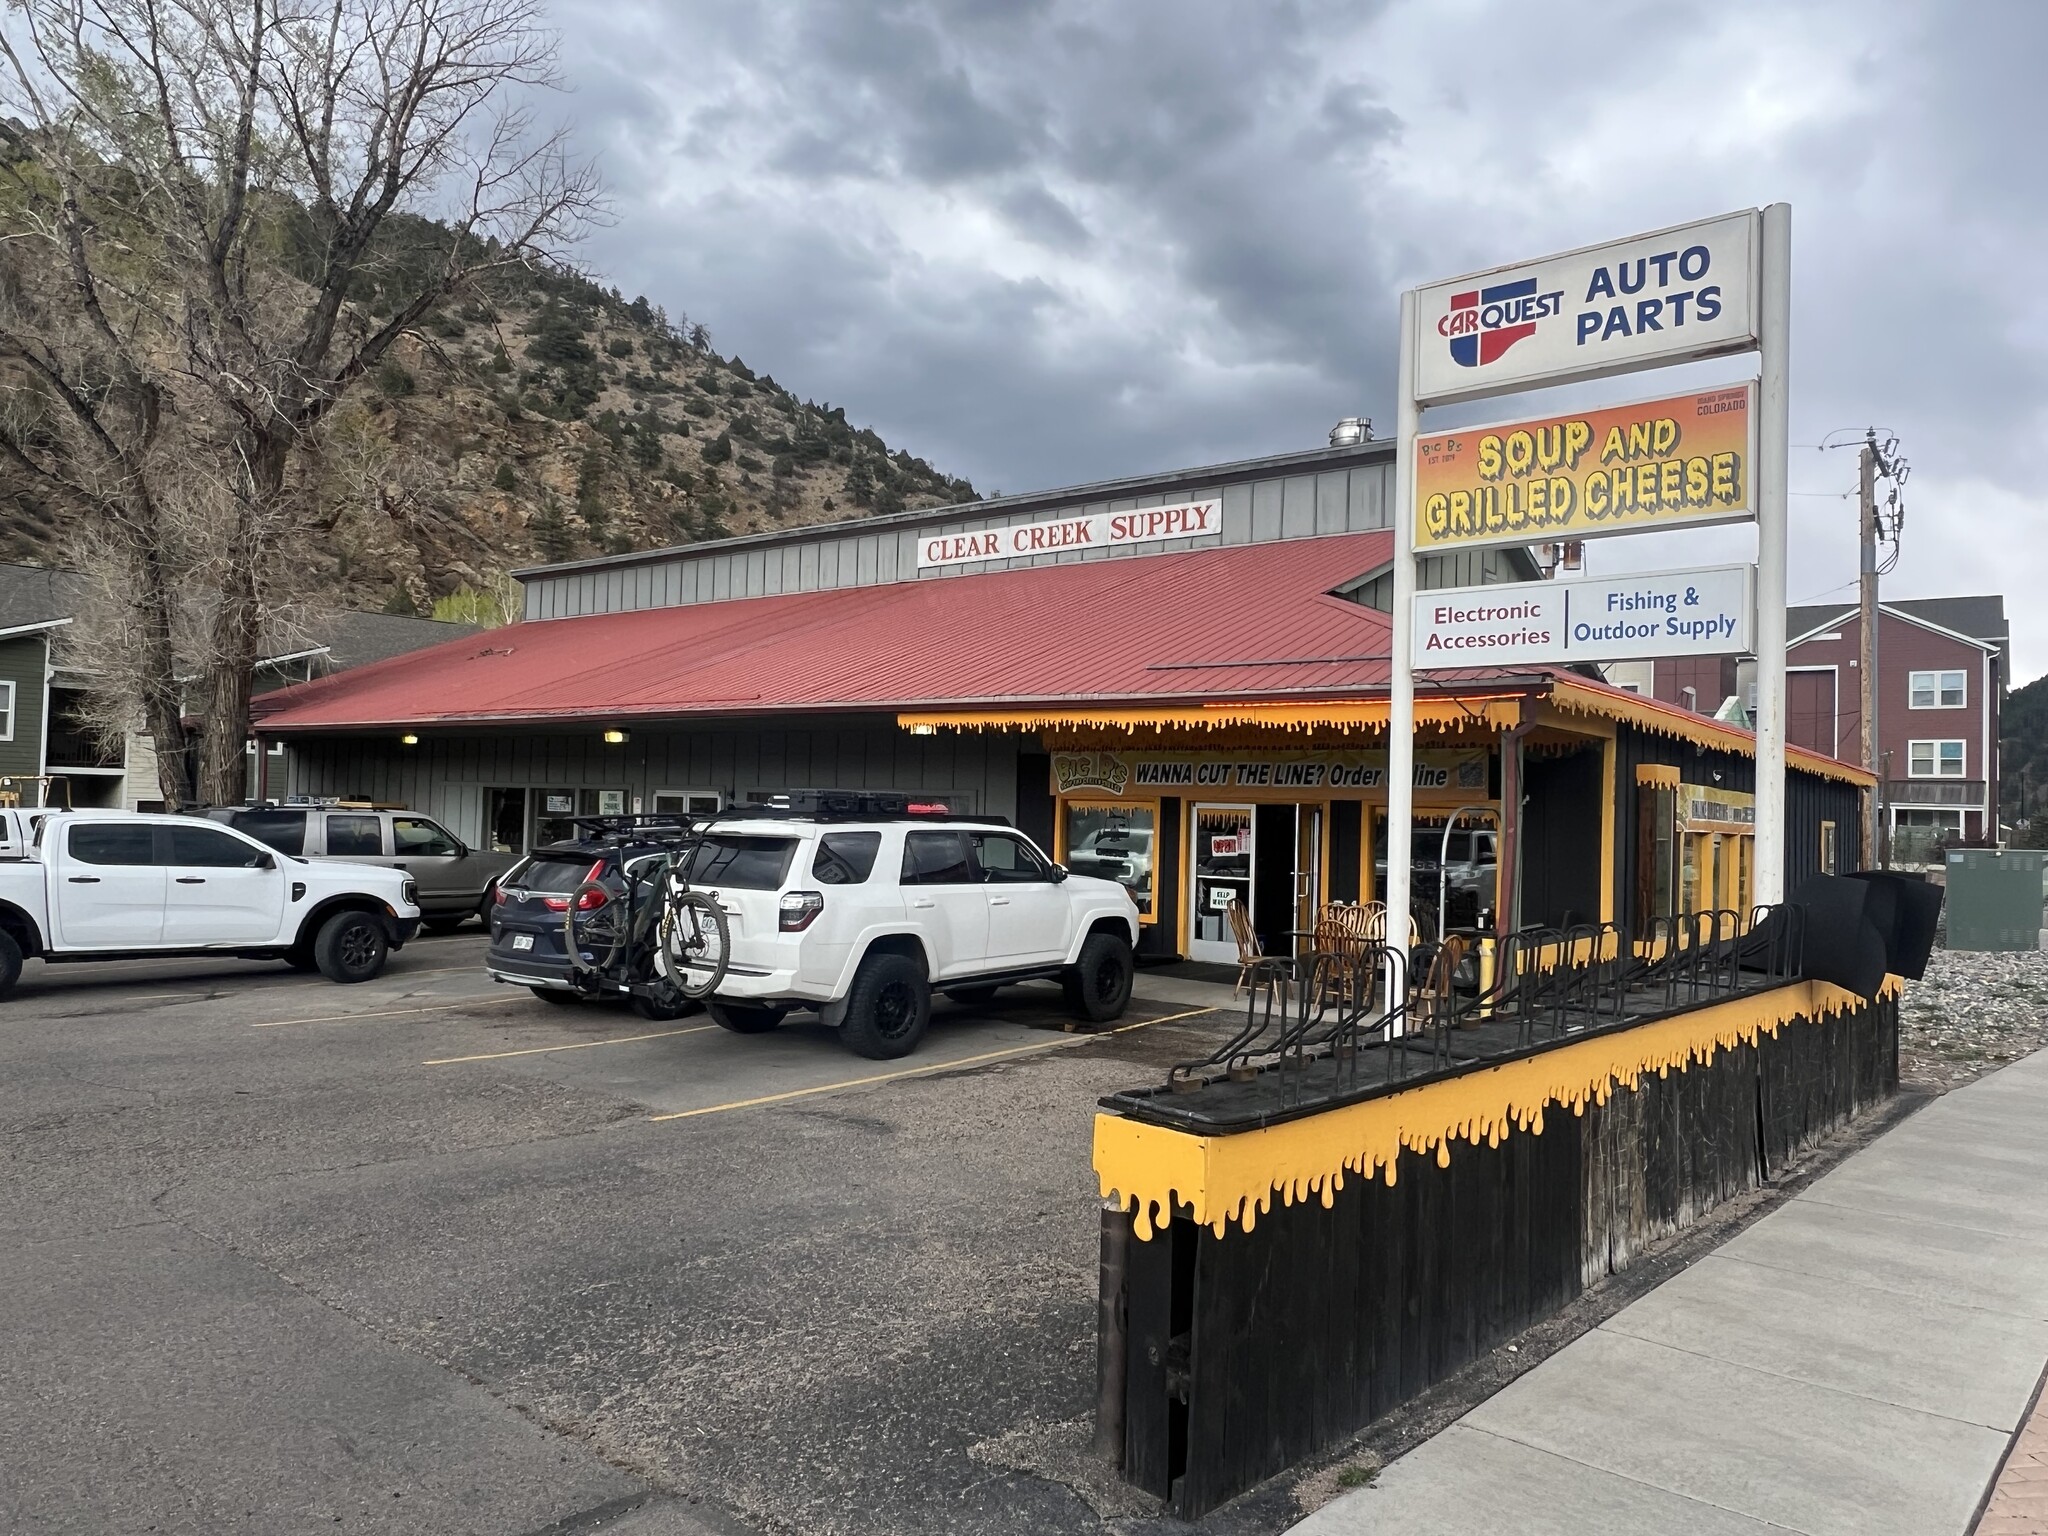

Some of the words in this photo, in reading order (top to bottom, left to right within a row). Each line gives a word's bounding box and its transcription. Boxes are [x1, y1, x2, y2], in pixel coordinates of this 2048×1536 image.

[1585, 245, 1711, 303] AUTO
[1438, 291, 1564, 337] CARQUEST
[1577, 285, 1722, 346] PARTS
[1697, 399, 1746, 416] COLORADO
[1422, 443, 1441, 456] BIG
[1478, 421, 1593, 481] SOUP
[1600, 418, 1680, 463] AND
[1425, 476, 1576, 539] GRILLED
[1584, 452, 1740, 517] CHEESE
[927, 533, 1000, 562] CLEAR
[1013, 520, 1093, 551] CREEK
[1110, 504, 1213, 541] SUPPLY
[1434, 601, 1541, 625] Electronic
[1607, 590, 1676, 614] Fishing
[1683, 586, 1699, 606] &
[1426, 628, 1550, 651] Accessories
[1574, 621, 1660, 642] Outdoor
[1666, 613, 1736, 640] Supply
[1054, 756, 1091, 782] BIG
[1136, 763, 1192, 783] WANNA
[1198, 764, 1232, 783] CUT
[1236, 764, 1270, 784] THE
[1273, 764, 1326, 786] LINE?
[1331, 764, 1382, 786] Order
[1213, 839, 1236, 853] OPEN
